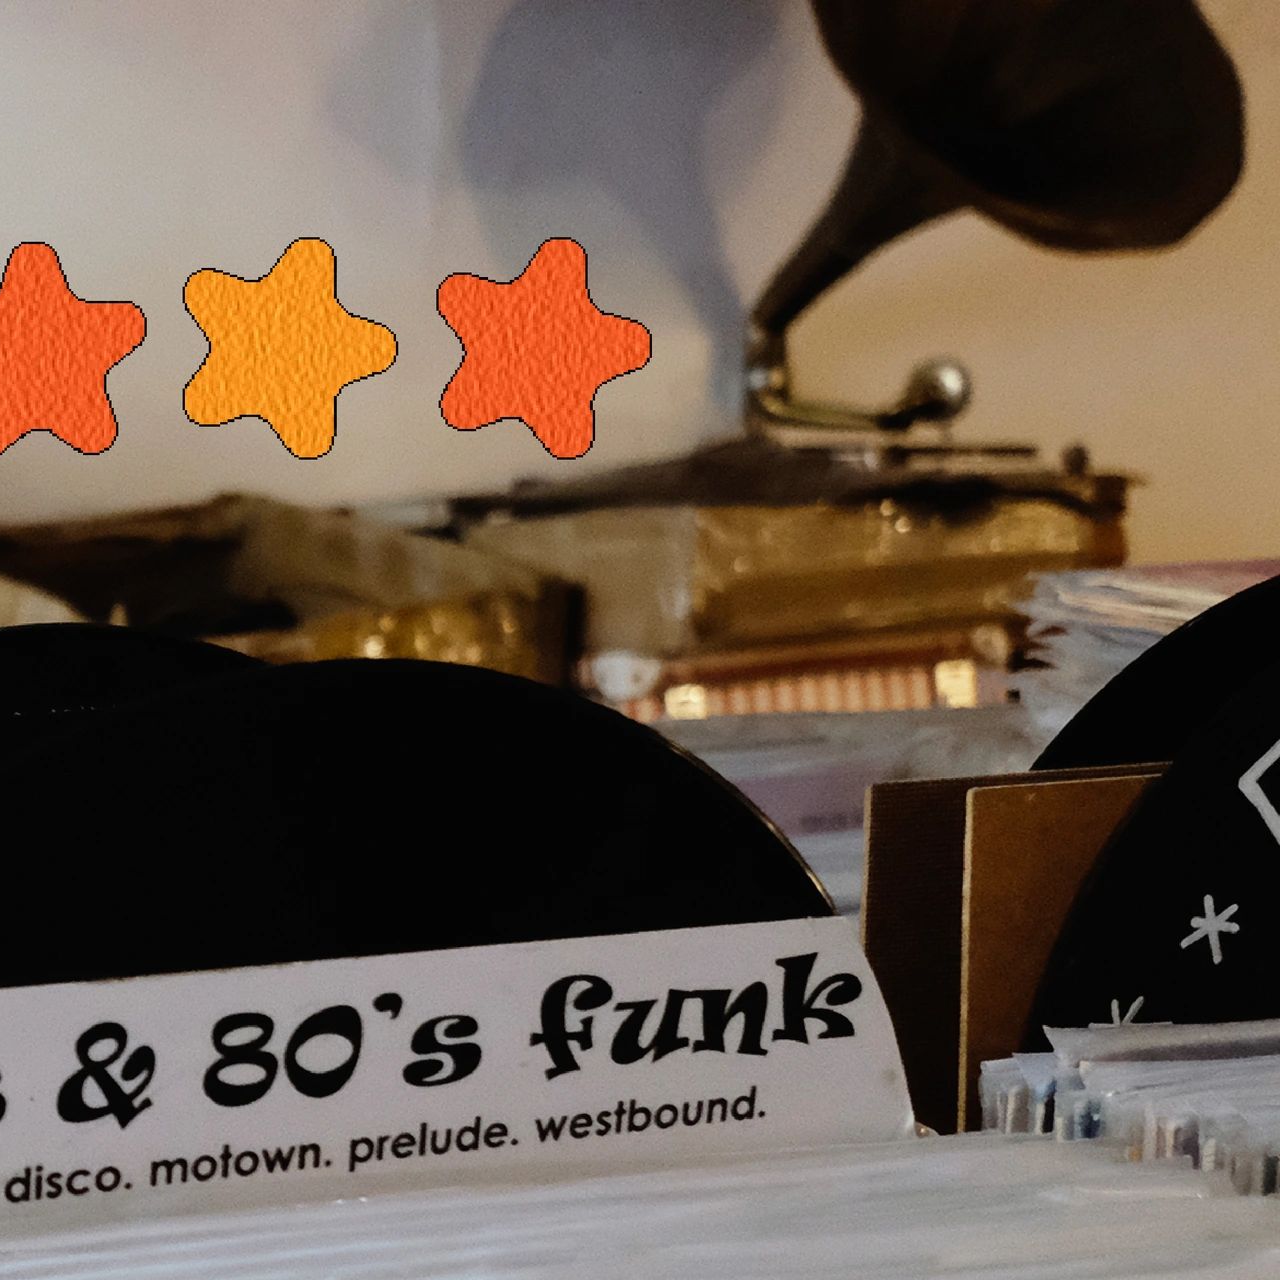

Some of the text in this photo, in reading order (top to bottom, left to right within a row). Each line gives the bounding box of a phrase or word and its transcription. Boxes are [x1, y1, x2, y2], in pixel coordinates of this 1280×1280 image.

[56, 1021, 156, 1130] &
[202, 992, 483, 1108] 80's
[529, 952, 864, 1081] funk
[4, 1165, 133, 1204] disco.
[149, 1144, 332, 1187] motown.
[348, 1122, 519, 1173] prelude.
[534, 1085, 766, 1143] westbound.
